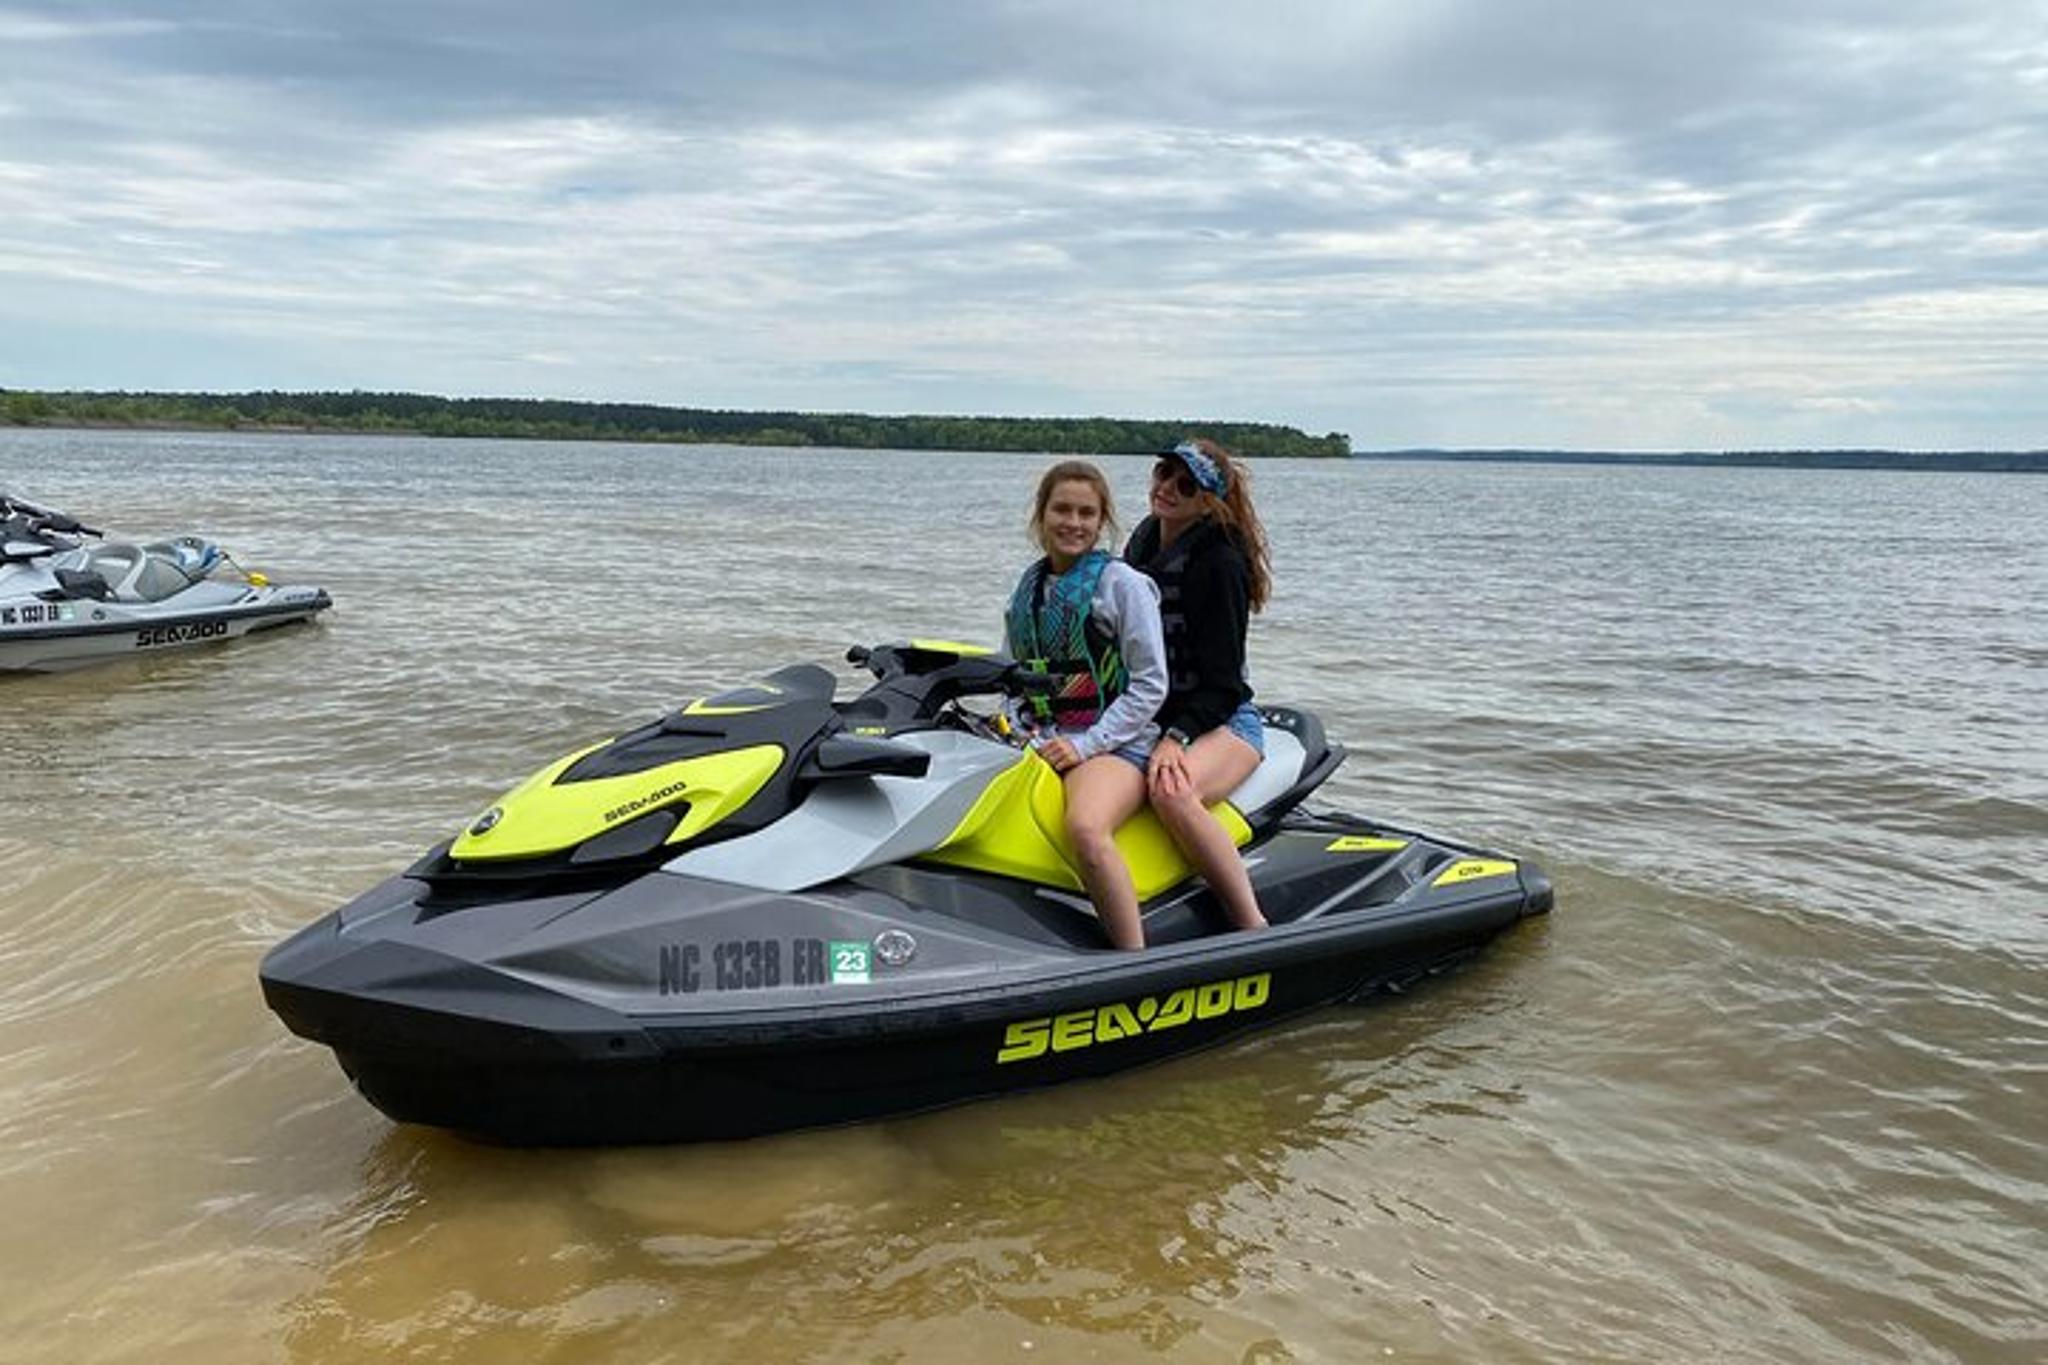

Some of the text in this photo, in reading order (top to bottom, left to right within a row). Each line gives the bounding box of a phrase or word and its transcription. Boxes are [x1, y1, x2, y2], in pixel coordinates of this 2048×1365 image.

[659, 938, 825, 995] NC 1338 ER
[836, 951, 866, 971] 23
